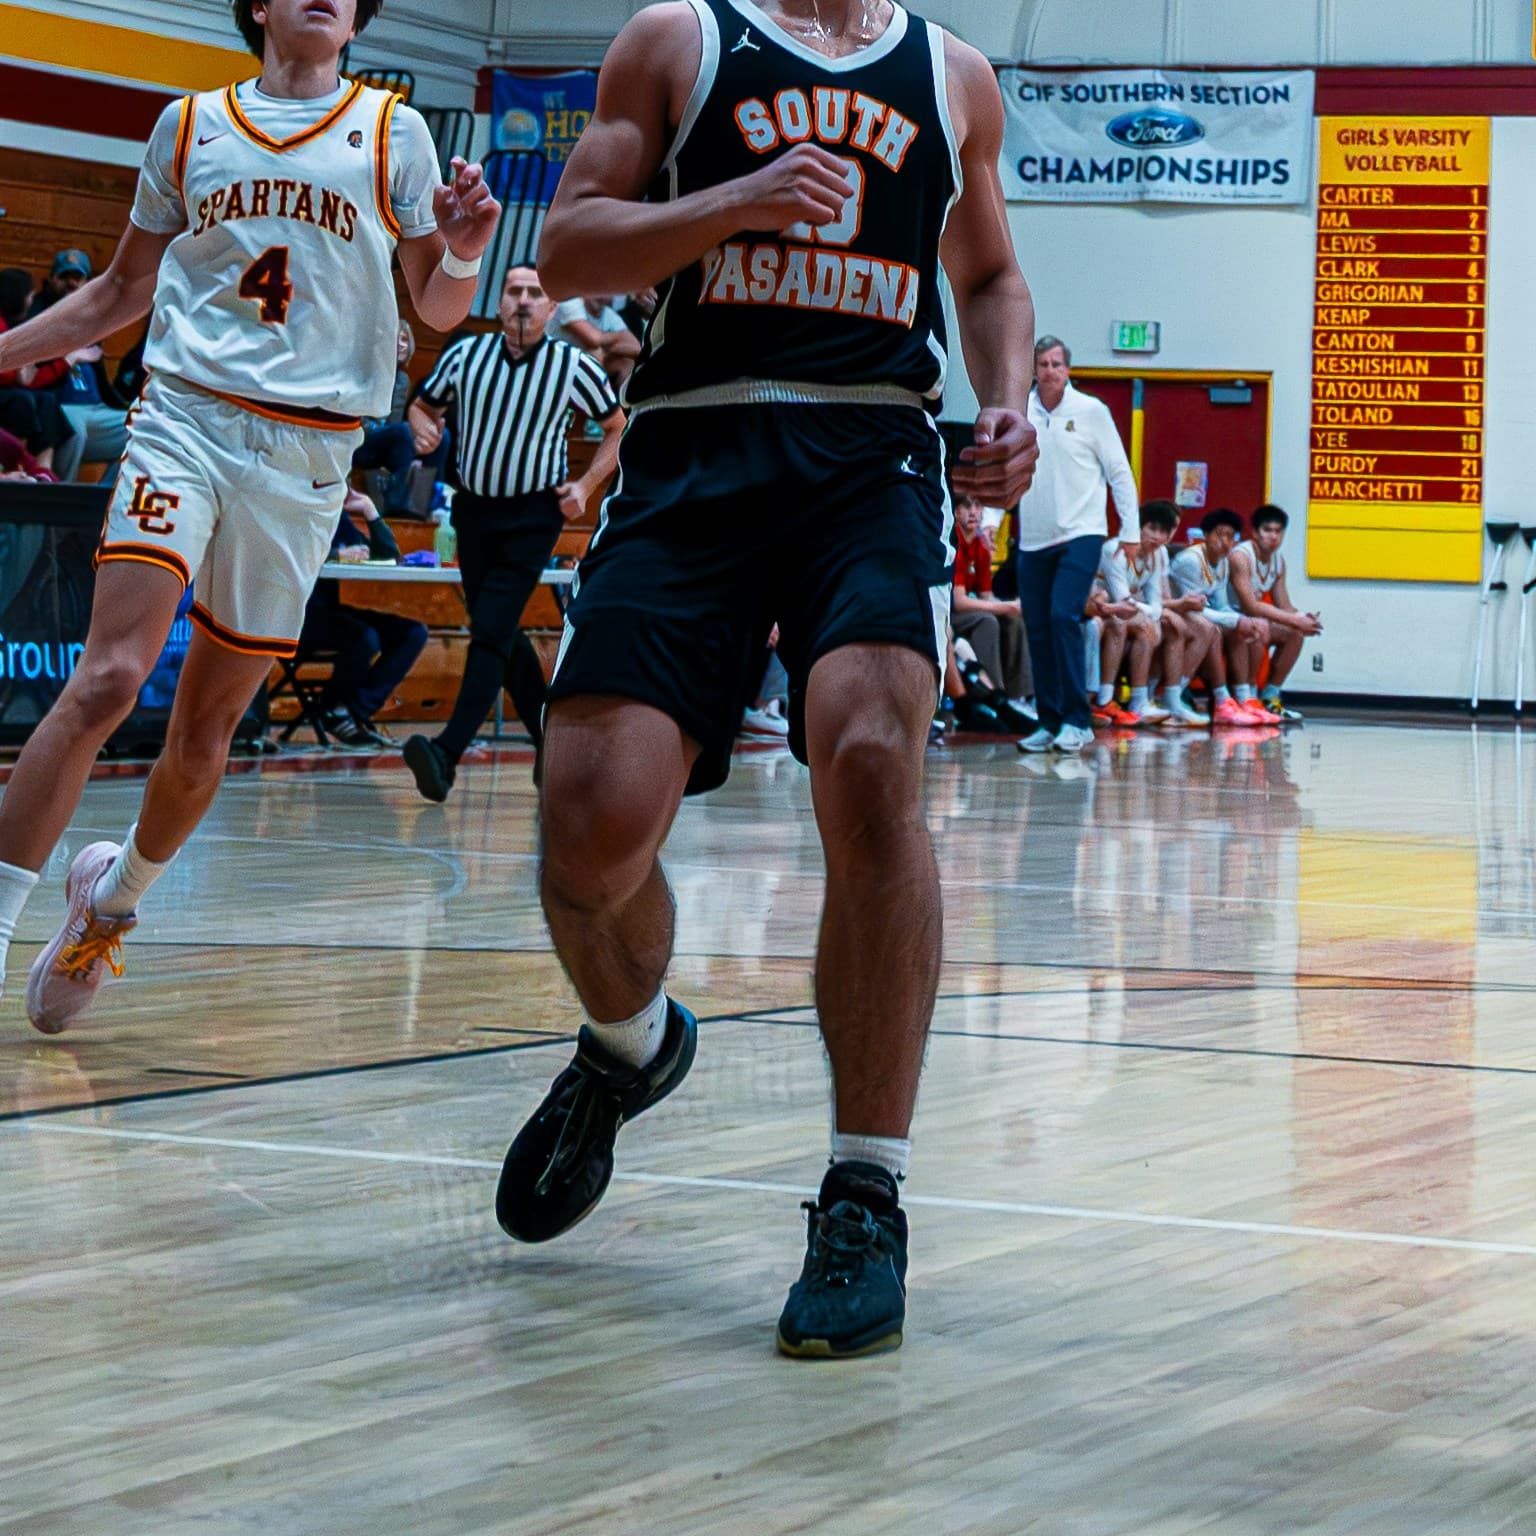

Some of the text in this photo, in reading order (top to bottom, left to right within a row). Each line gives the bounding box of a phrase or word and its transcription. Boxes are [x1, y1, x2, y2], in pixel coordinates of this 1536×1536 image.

[1018, 82, 1290, 106] CIF SOUTHERN SECTION
[734, 85, 920, 173] SOUTH
[1126, 116, 1183, 143] Ford
[1336, 129, 1471, 147] GIRLS VARSITY
[1017, 154, 1290, 186] CHAMPIONSHIPS
[1344, 154, 1462, 172] VOLLEYBALL
[1322, 187, 1479, 204] CARTER 1
[193, 178, 358, 242] SPARTANS
[1320, 212, 1479, 229] MA 2
[1320, 236, 1377, 252] LEWIS
[1319, 260, 1478, 278] CLARK 4
[238, 245, 293, 325] 4
[1318, 285, 1478, 302] GRIGORIAN 5
[1317, 308, 1371, 324] KEMP
[1315, 333, 1395, 350] CANTON
[1315, 358, 1478, 376] KESHISHIAN 11
[1316, 382, 1420, 400] TATOULIAN
[1315, 407, 1393, 423] TOLAND
[1315, 432, 1348, 448] YEE
[1314, 455, 1478, 476] PURDY 21
[1313, 481, 1479, 501] MARCHETTI 22
[126, 475, 181, 536] LC
[0, 634, 86, 680] roup
